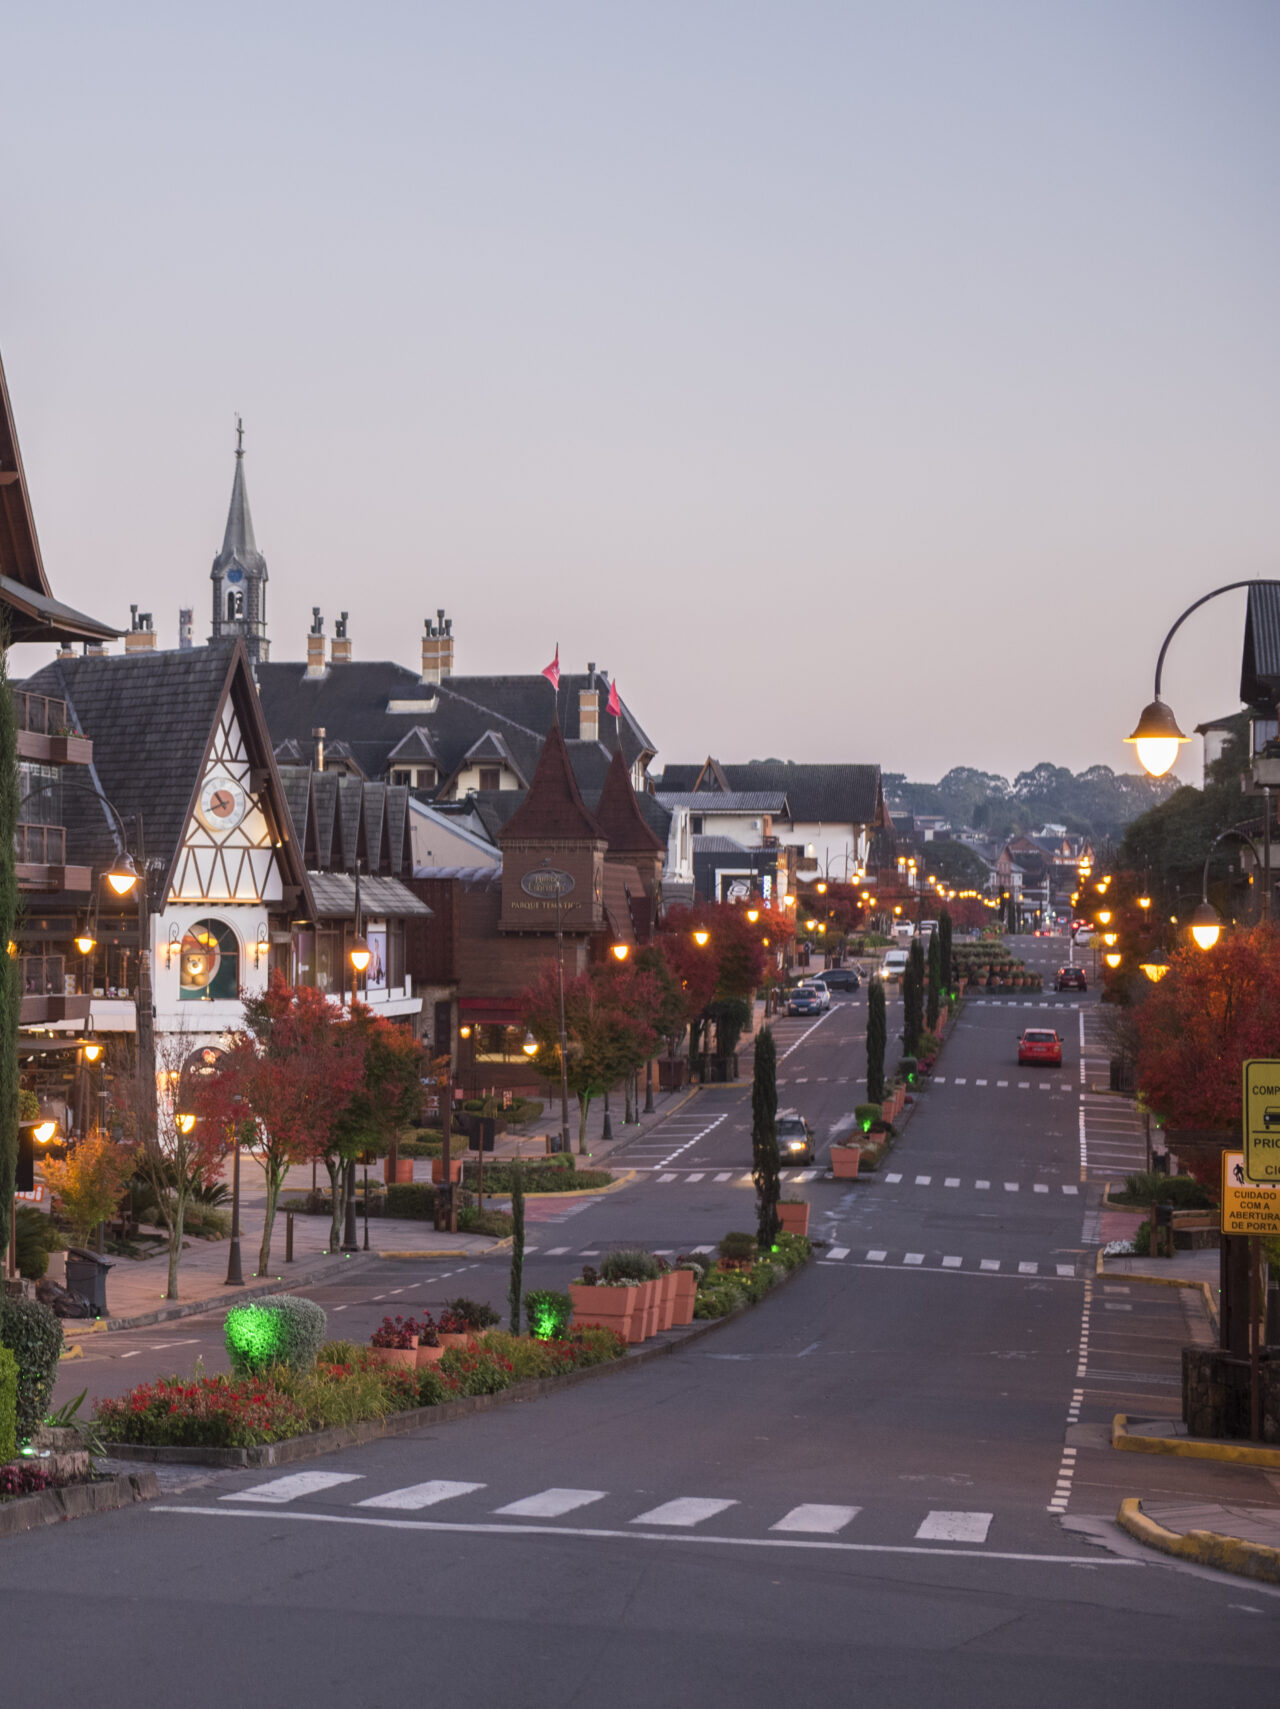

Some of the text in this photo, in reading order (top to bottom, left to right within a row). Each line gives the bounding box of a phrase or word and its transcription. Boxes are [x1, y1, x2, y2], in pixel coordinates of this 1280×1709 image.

[511, 901, 539, 910] PARQUE
[1265, 1165, 1280, 1176] CI
[1234, 1191, 1277, 1200] CUIDADO
[1240, 1201, 1270, 1210] COM A
[1229, 1211, 1280, 1221] ABERTURA
[1247, 1222, 1278, 1231] PORTA
